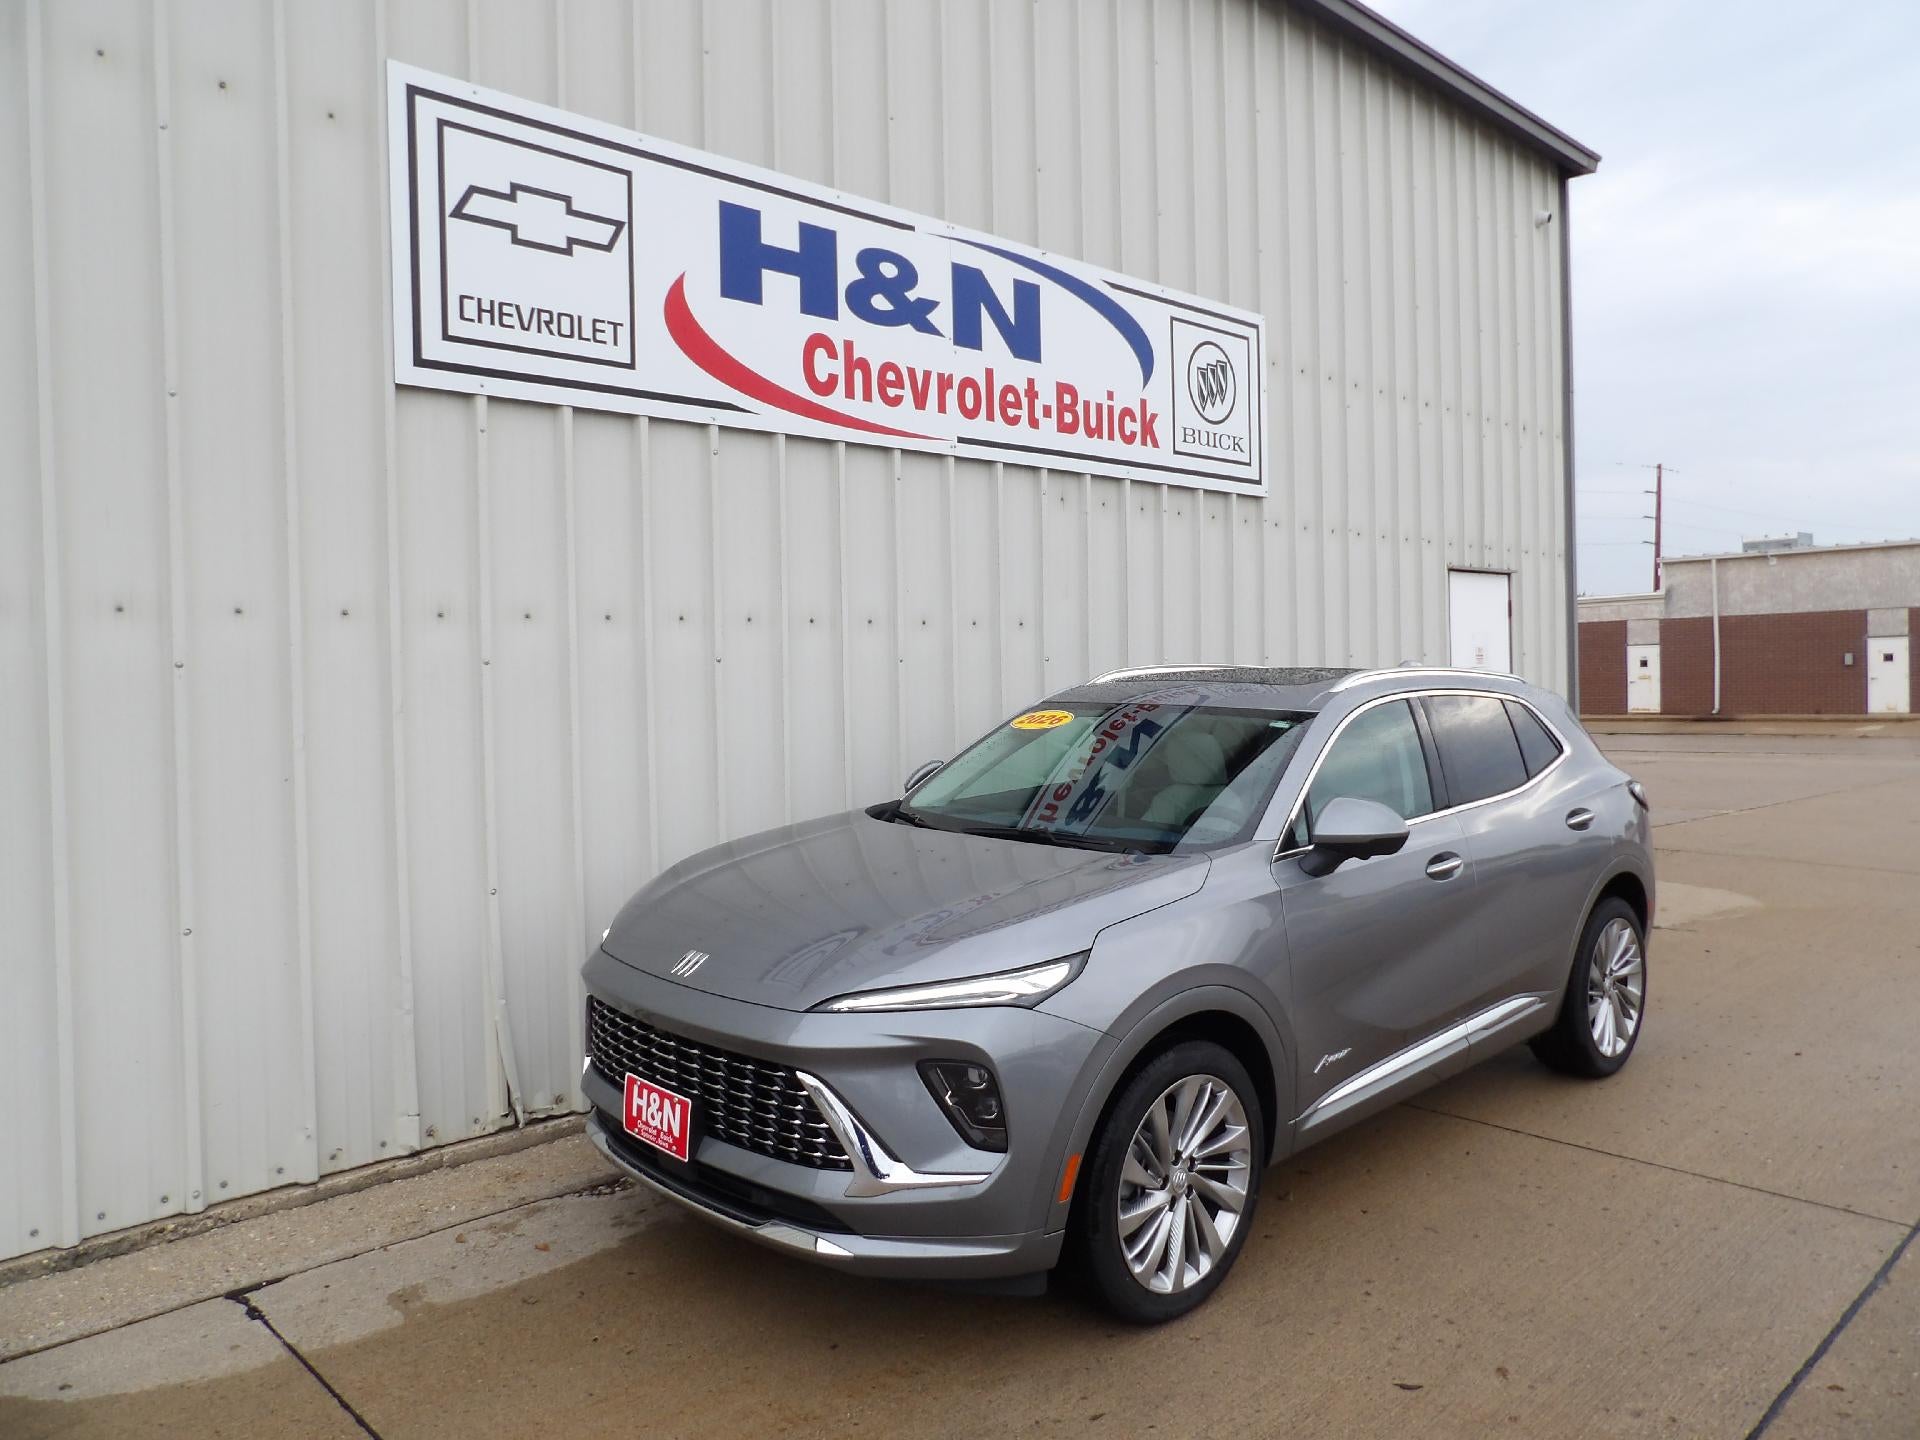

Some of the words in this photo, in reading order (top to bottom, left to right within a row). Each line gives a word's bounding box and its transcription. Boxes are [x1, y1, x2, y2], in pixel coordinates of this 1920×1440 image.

[719, 200, 1042, 364] H&N
[459, 294, 624, 347] CHEVROLET
[802, 332, 1160, 449] Chevrolet-Buick
[1181, 426, 1245, 454] BUICK
[1014, 714, 1069, 725] 2026
[632, 1084, 681, 1138] H&N
